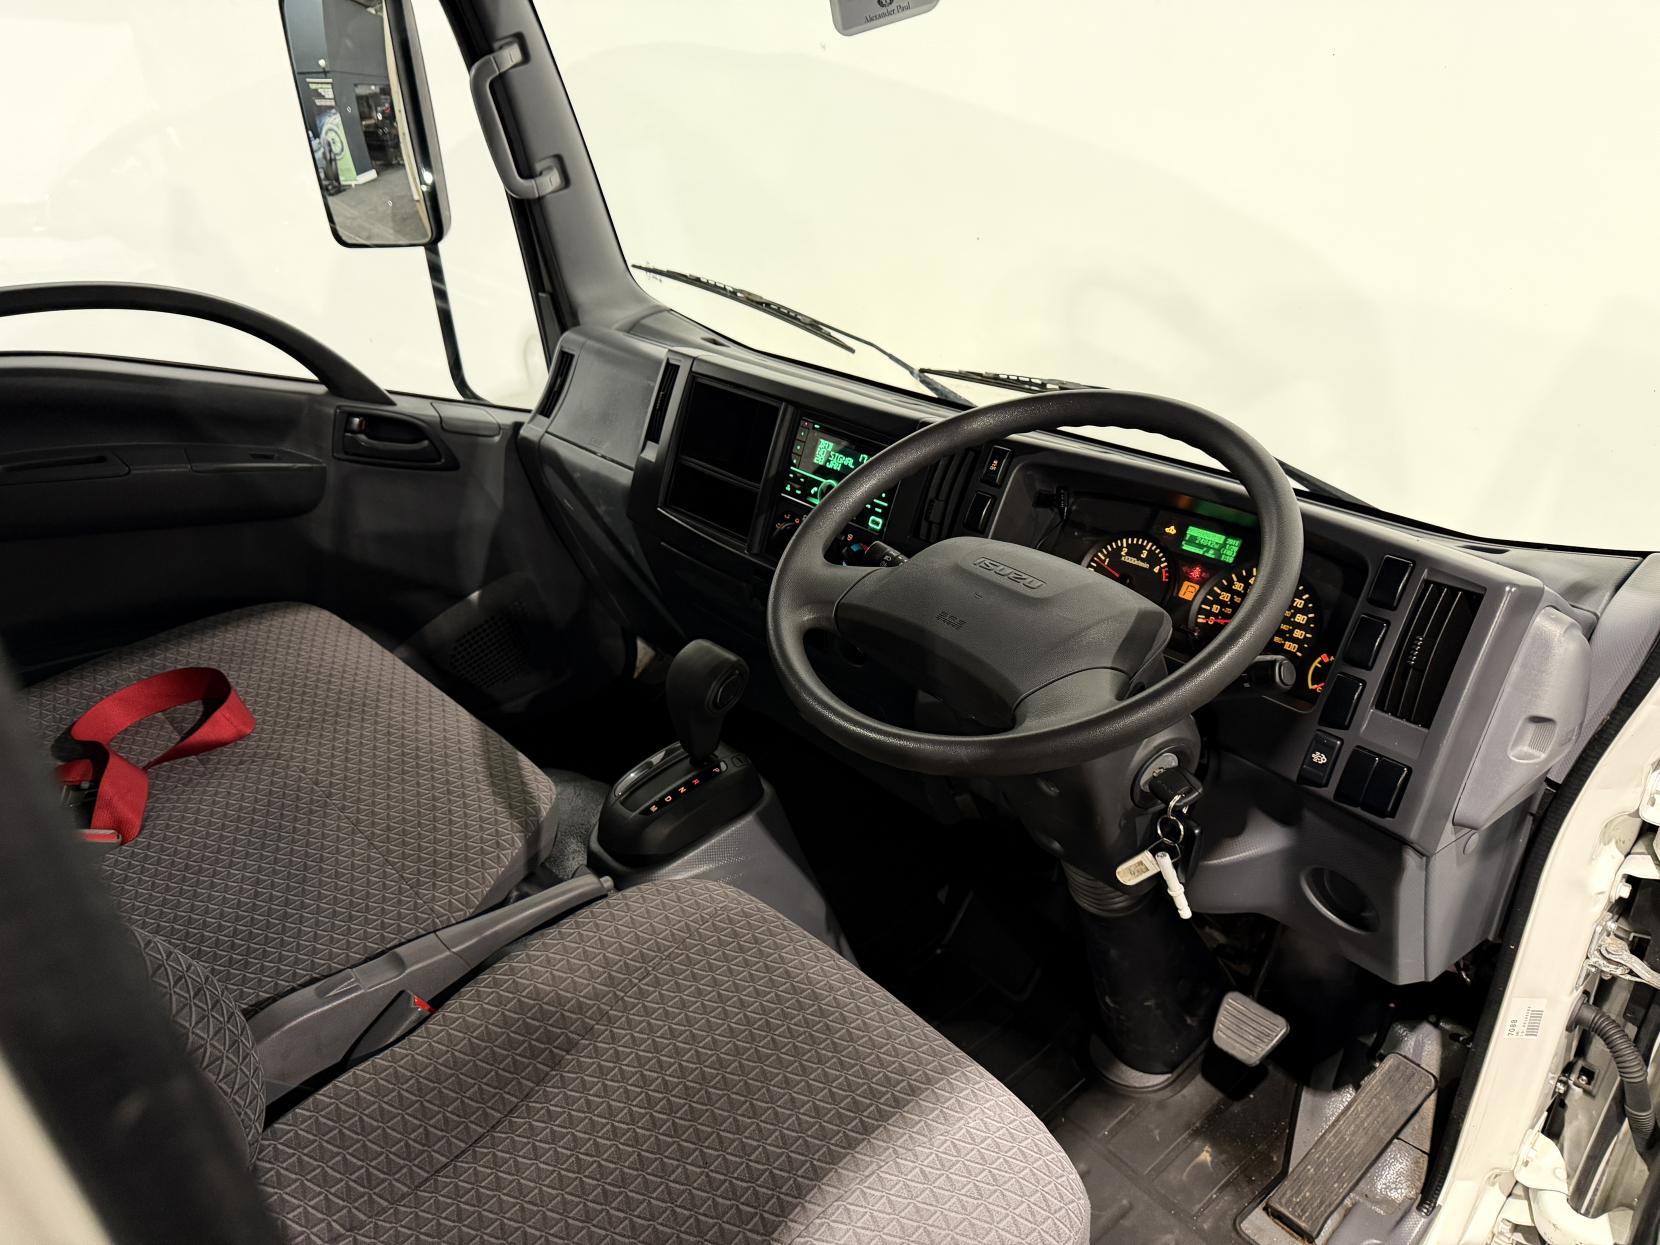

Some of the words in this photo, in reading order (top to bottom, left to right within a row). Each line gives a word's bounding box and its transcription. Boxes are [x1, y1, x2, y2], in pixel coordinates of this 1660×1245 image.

[864, 8, 896, 24] Alexander
[896, 2, 911, 14] Paul
[828, 451, 855, 469] SIGNAL
[1121, 547, 1128, 556] 2
[1140, 550, 1148, 558] 3
[972, 557, 1047, 590] ISUZU
[1153, 565, 1160, 573] 4
[1232, 581, 1244, 591] 30
[1219, 591, 1231, 602] 20
[1293, 598, 1304, 608] 70
[1211, 604, 1220, 613] 10
[1295, 613, 1307, 624] 80
[1292, 629, 1305, 639] 90
[1283, 641, 1298, 652] 100
